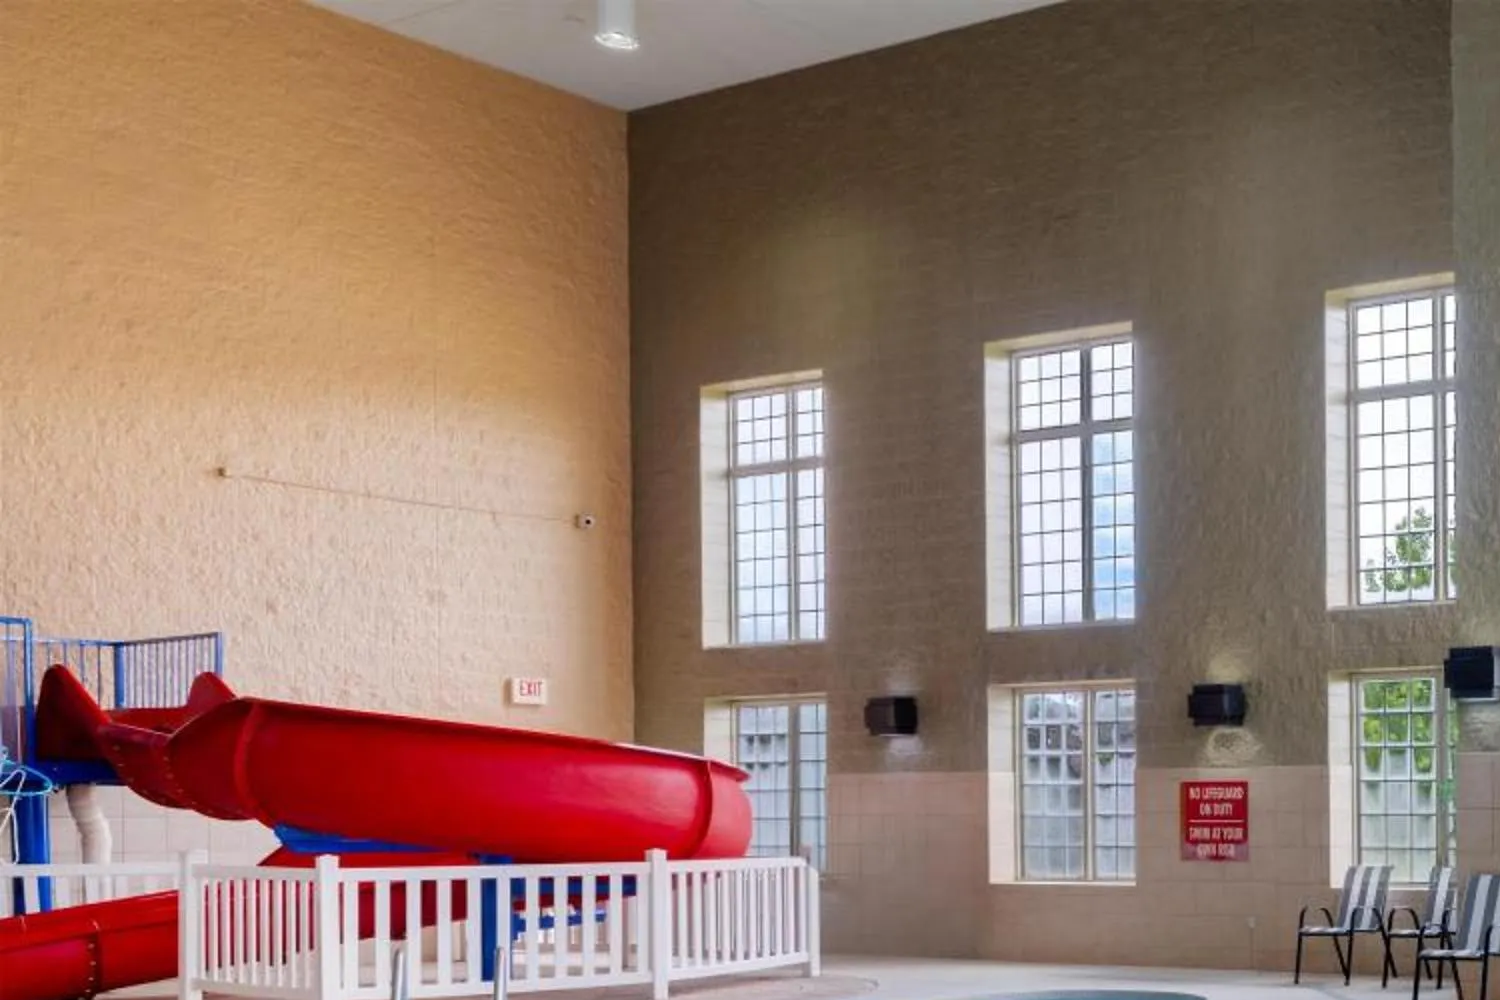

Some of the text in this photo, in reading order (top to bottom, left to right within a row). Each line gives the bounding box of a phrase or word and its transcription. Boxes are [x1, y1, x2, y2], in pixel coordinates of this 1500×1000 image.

[519, 679, 543, 696] EXIT
[1189, 787, 1244, 799] NO LIFEGUARD
[1199, 803, 1232, 816] ON DUTY
[1189, 827, 1210, 840] SWIM
[1222, 827, 1243, 840] YOUR
